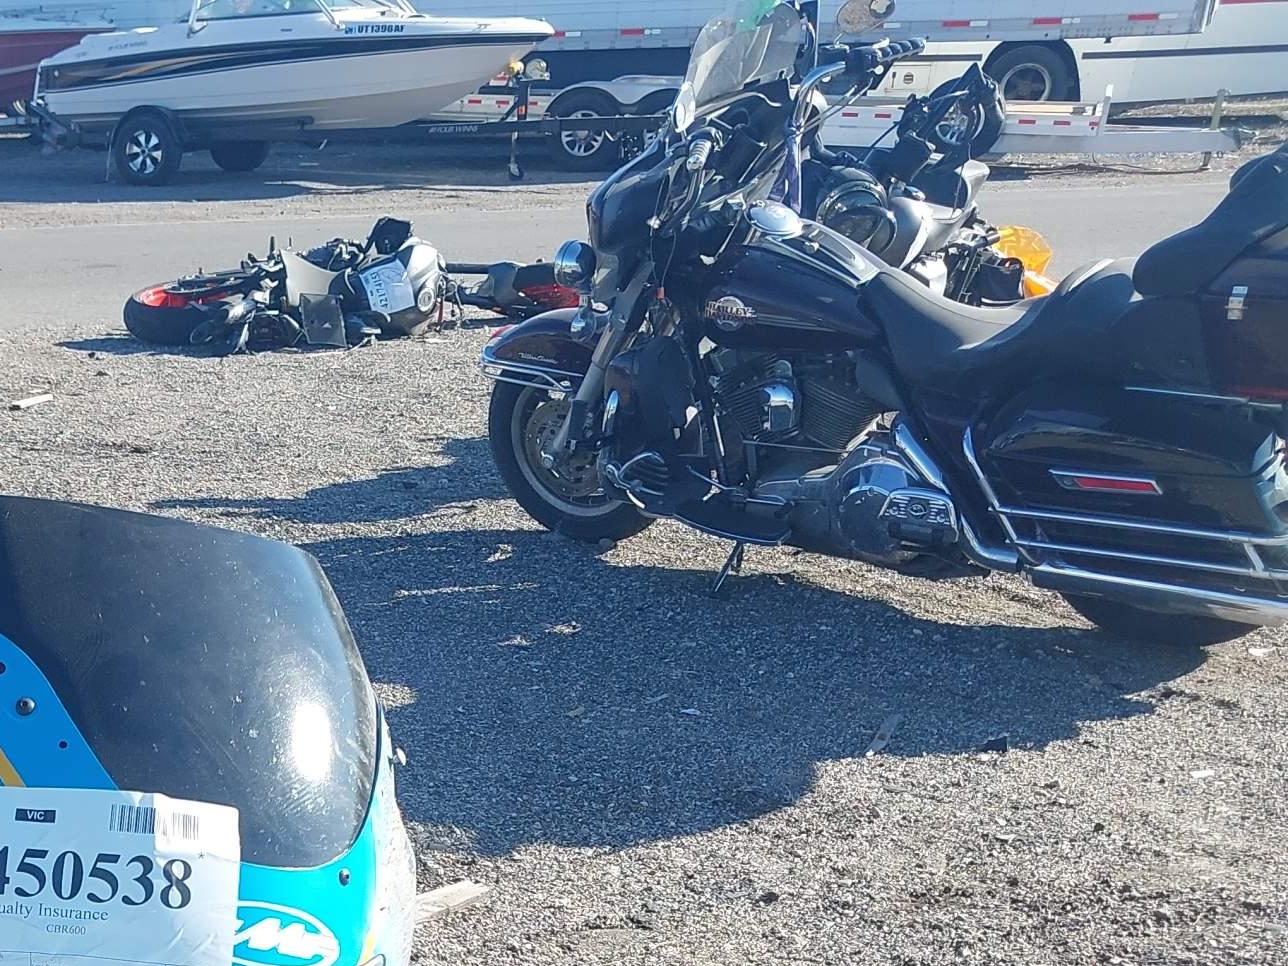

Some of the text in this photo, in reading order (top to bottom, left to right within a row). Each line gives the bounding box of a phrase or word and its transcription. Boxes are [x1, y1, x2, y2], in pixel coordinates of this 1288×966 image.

[27, 810, 45, 821] VIC
[38, 903, 109, 921] Insurance
[46, 923, 87, 935] CBR600
